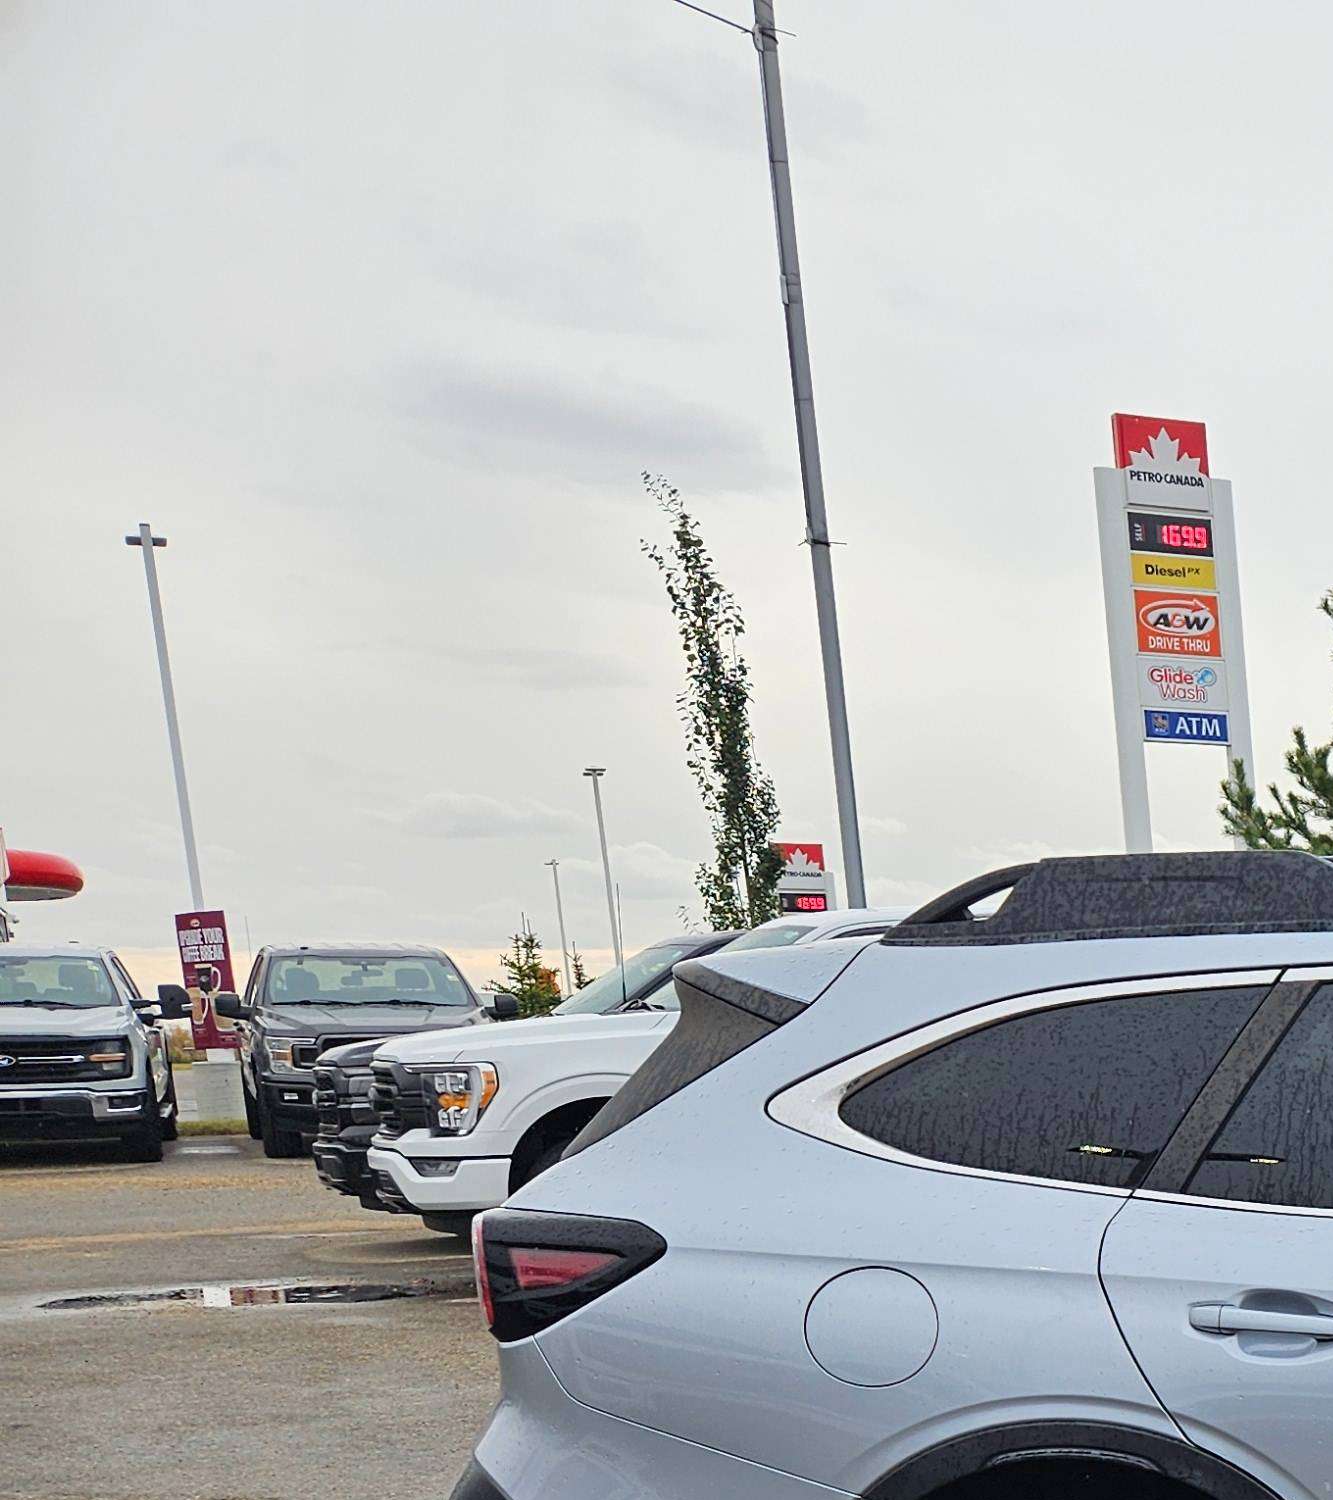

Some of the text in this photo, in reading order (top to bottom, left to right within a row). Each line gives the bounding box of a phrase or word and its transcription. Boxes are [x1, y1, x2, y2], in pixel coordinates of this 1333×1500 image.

[1144, 564, 1186, 578] Diesel
[1152, 613, 1210, 631] A&W
[1148, 636, 1211, 652] DRIVE THRU
[1149, 667, 1194, 684] Glide
[1159, 682, 1206, 701] Wash
[1175, 716, 1221, 737] ATM
